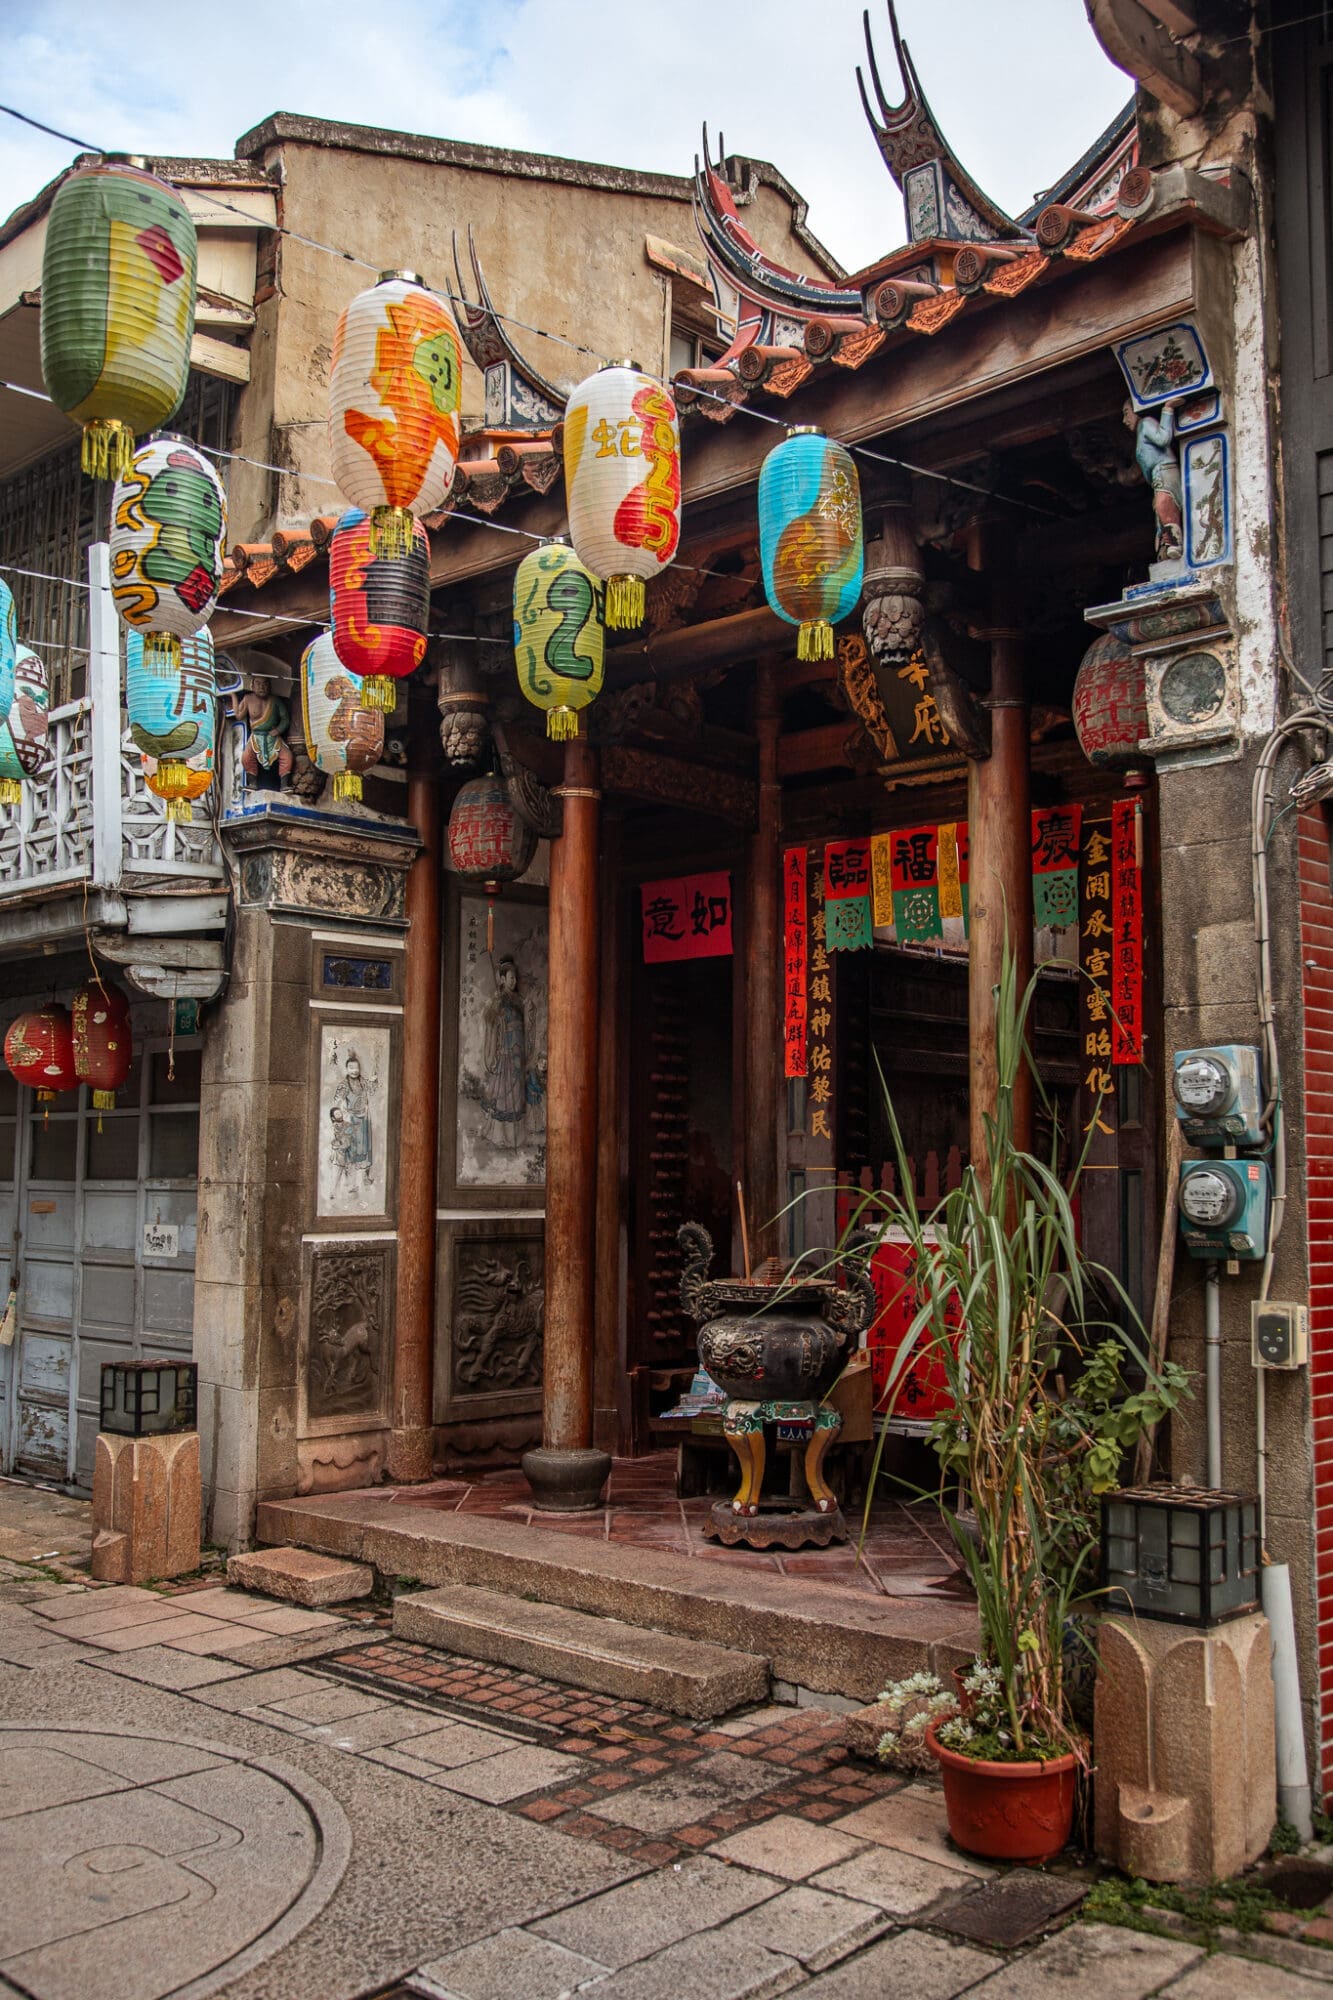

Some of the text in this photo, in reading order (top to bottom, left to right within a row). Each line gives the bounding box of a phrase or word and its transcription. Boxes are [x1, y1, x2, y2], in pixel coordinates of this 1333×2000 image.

[591, 416, 643, 457] 蛇
[828, 848, 868, 890] 臨
[894, 834, 936, 882] 福
